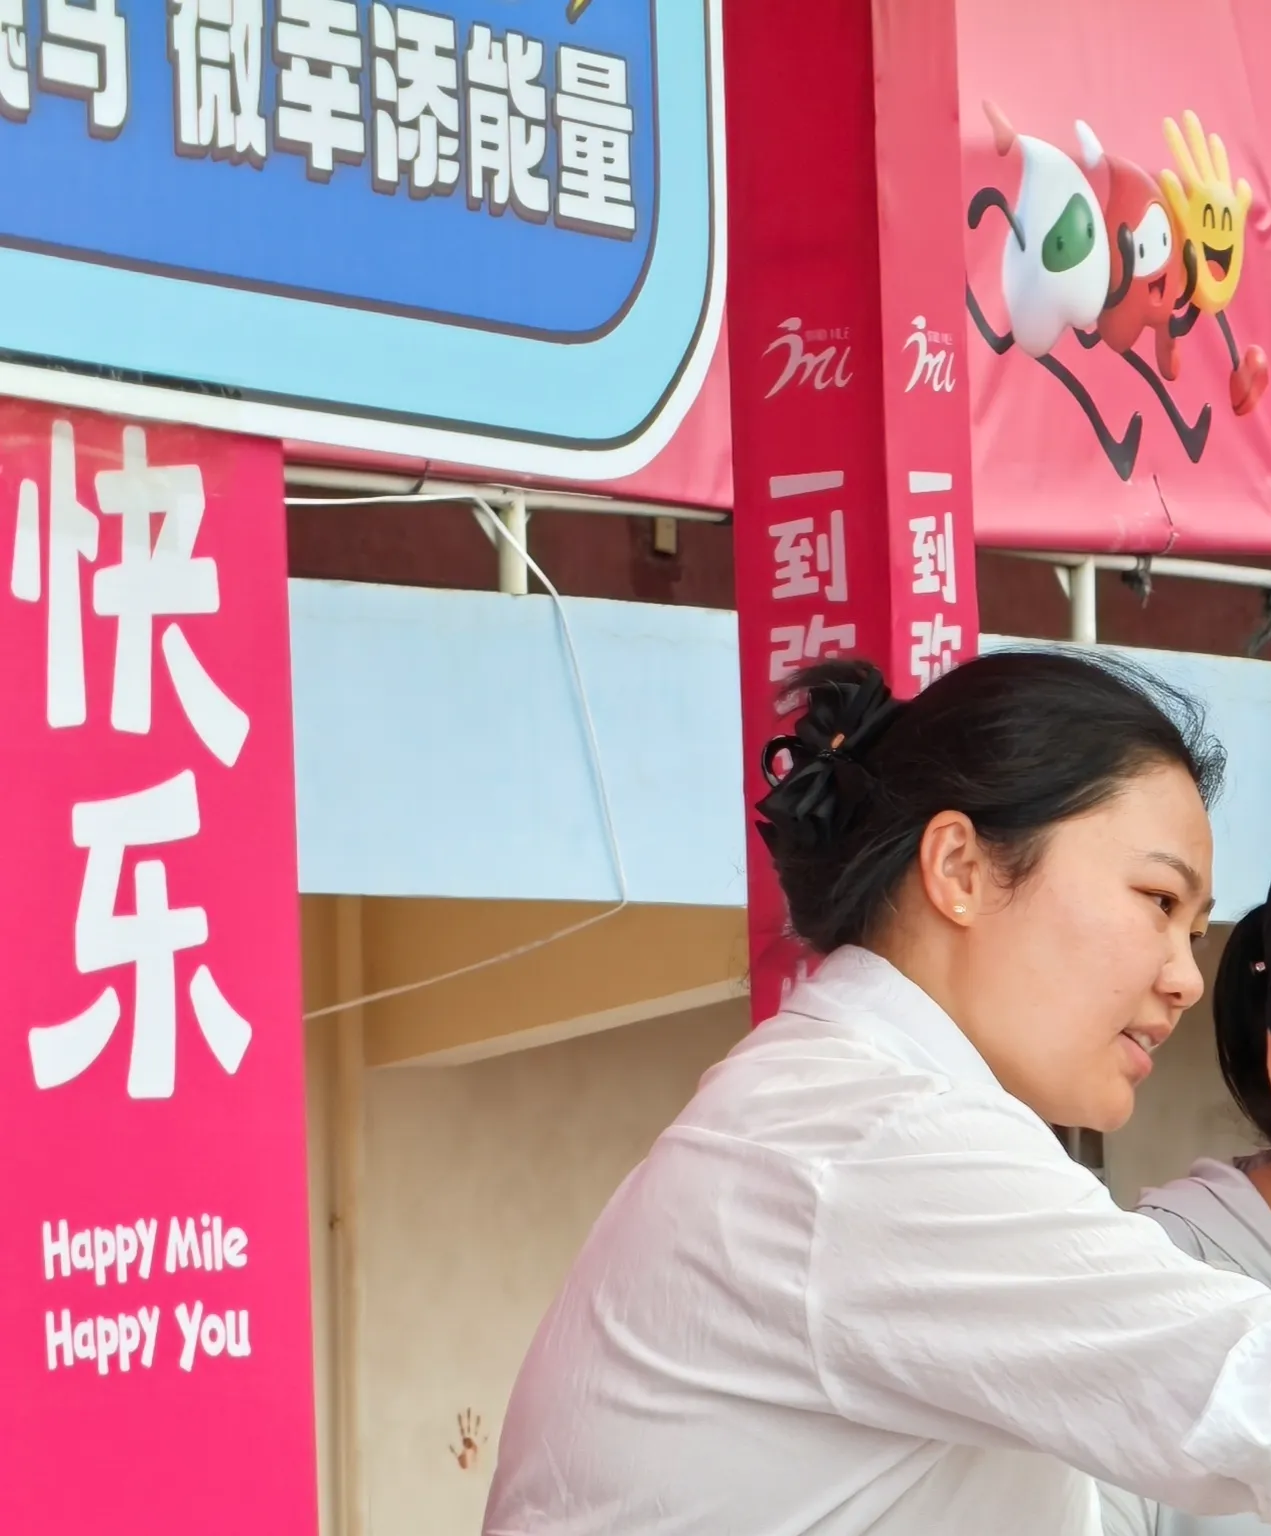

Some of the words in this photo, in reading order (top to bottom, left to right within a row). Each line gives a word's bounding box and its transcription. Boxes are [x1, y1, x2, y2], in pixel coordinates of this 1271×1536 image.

[10, 419, 252, 1101] 快乐
[42, 1217, 158, 1286] Happy
[165, 1213, 249, 1275] Mile
[45, 1306, 160, 1376] Happy
[175, 1300, 252, 1373] You
